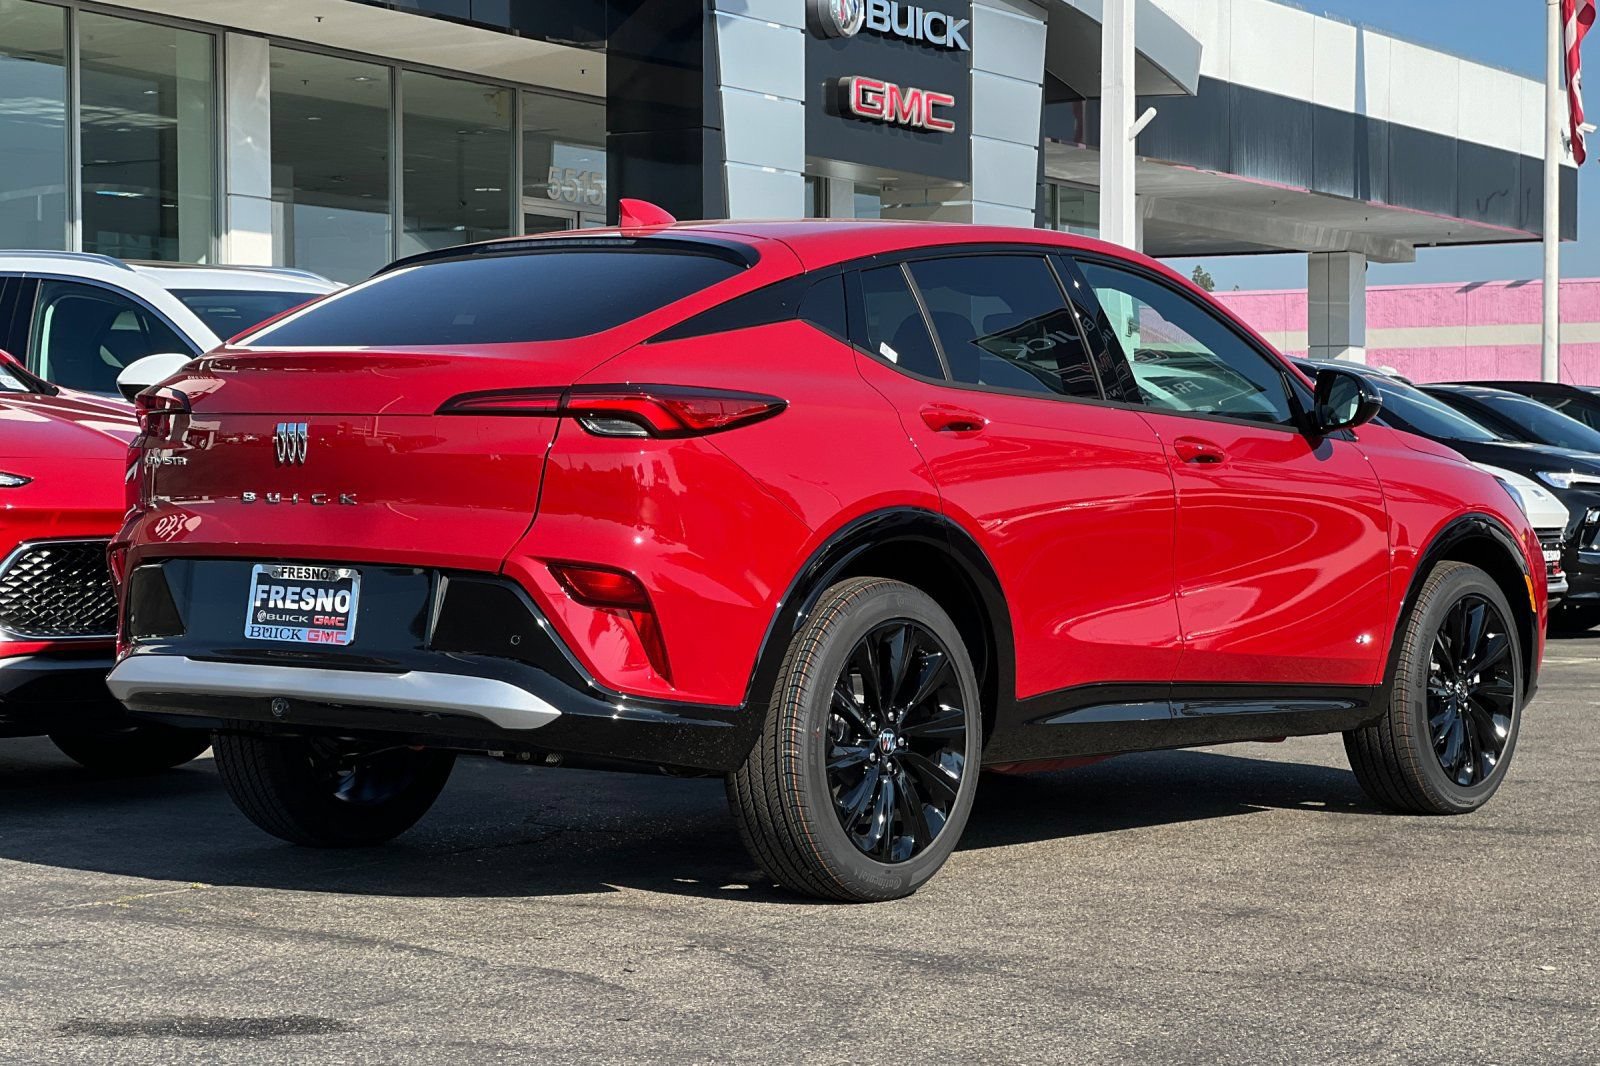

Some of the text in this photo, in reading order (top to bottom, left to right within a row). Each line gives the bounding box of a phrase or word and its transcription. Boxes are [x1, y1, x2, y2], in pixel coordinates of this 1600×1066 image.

[866, 0, 971, 51] BUICK
[851, 76, 955, 133] GMC
[547, 166, 604, 206] 5515
[242, 492, 358, 505] BUICK
[281, 566, 329, 580] FRESNO
[255, 584, 351, 613] FRESNO
[266, 613, 345, 627] BUICK GMC
[250, 625, 347, 643] BUICK GMC
